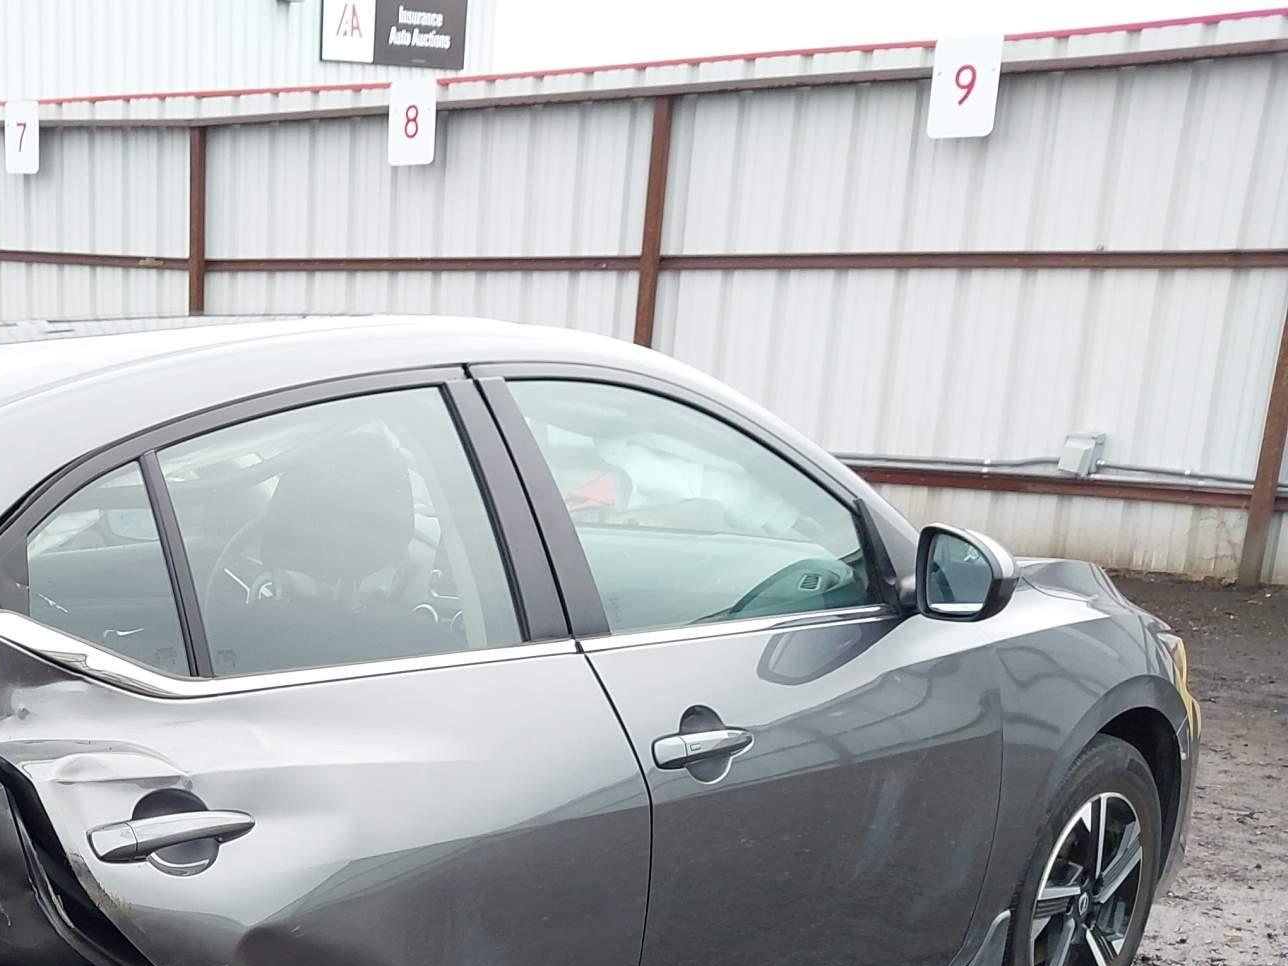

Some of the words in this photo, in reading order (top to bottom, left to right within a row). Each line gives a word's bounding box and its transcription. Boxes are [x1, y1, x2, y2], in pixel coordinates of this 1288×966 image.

[399, 5, 443, 27] Insurance
[389, 26, 412, 46] Auto
[411, 28, 451, 49] Auctions
[954, 64, 978, 107] 9
[404, 104, 419, 139] 8
[16, 122, 27, 152] 7
